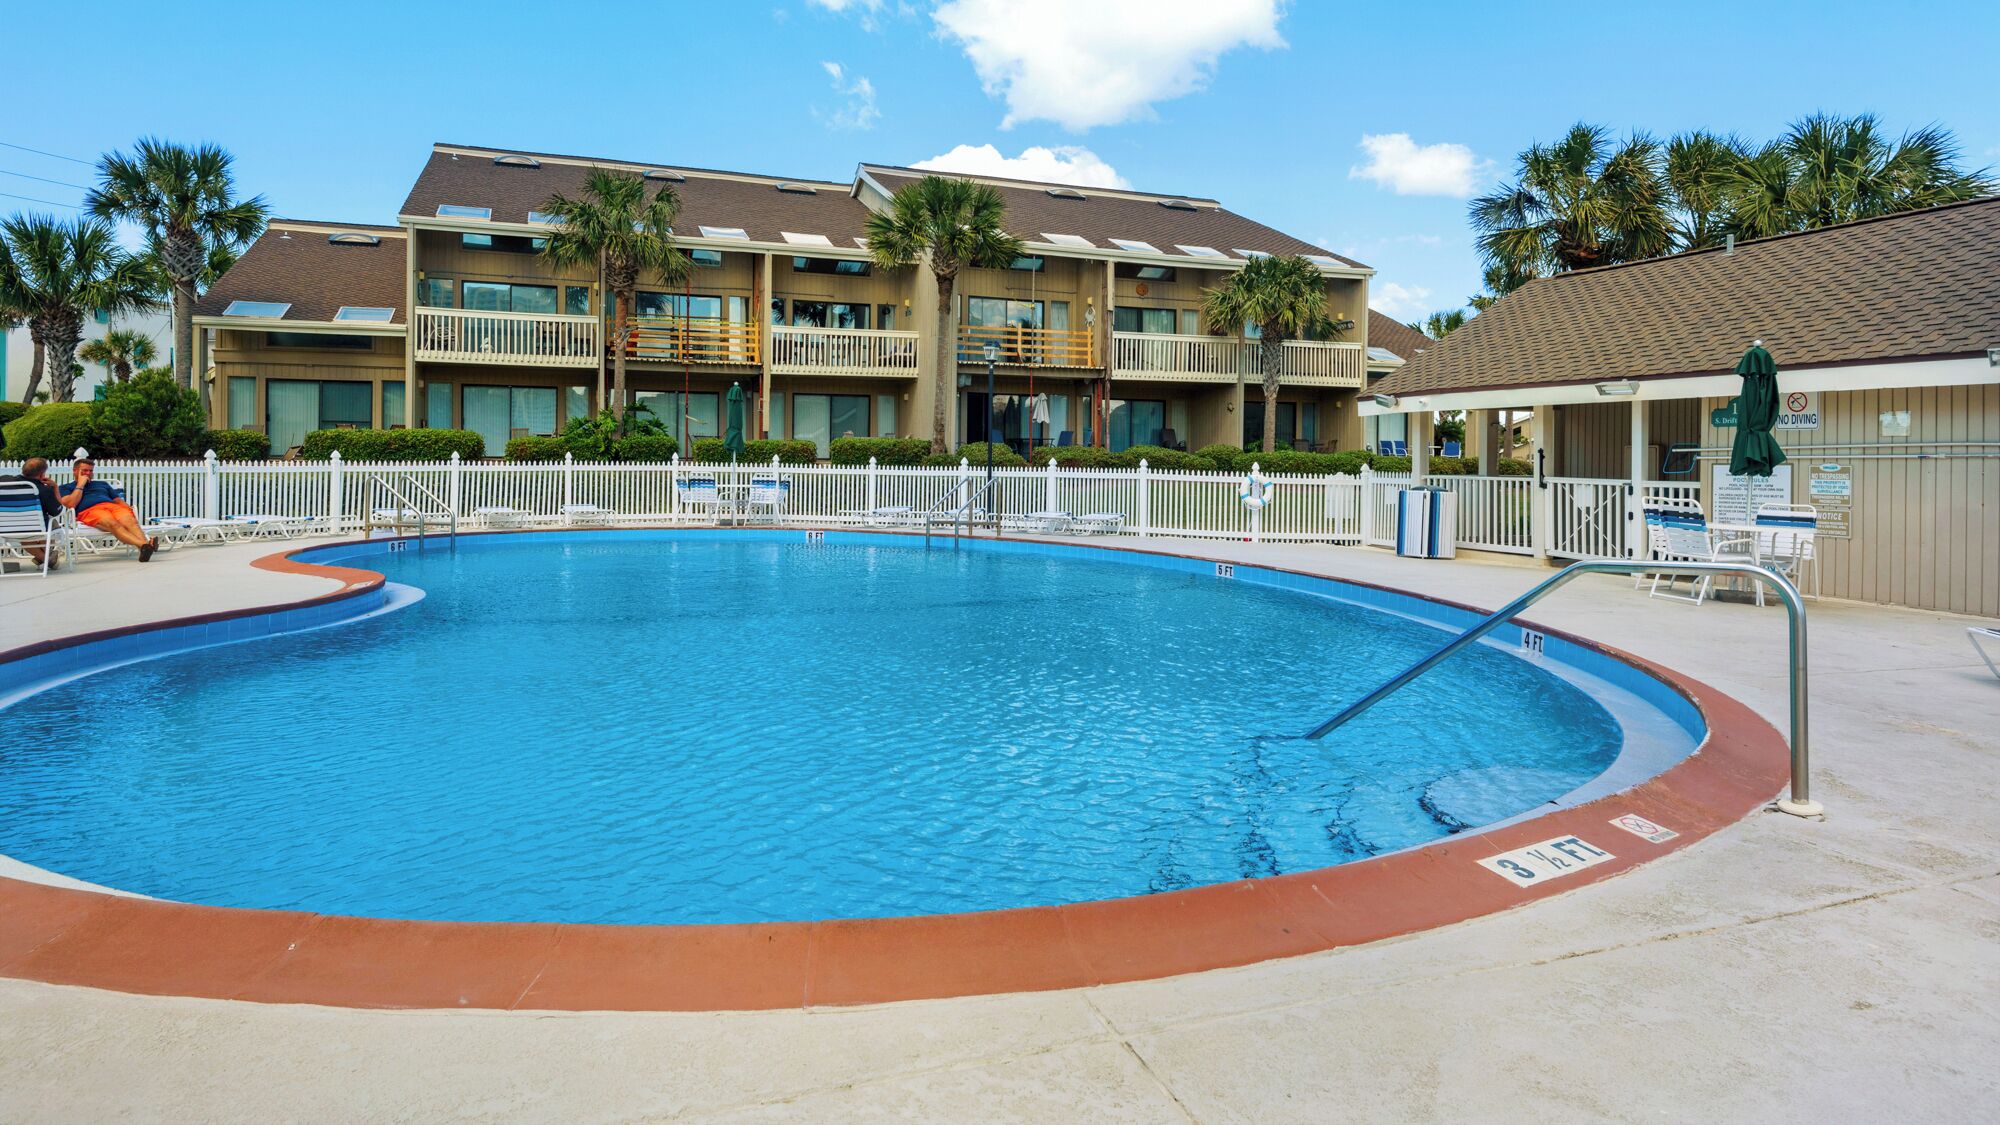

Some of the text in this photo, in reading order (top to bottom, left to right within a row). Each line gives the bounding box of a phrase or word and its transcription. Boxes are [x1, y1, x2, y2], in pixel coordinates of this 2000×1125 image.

[1778, 413, 1817, 425] NO DIVING
[1816, 512, 1843, 521] NOTICE
[1218, 564, 1223, 576] 5
[1524, 631, 1530, 648] 4
[1496, 859, 1536, 879] 3
